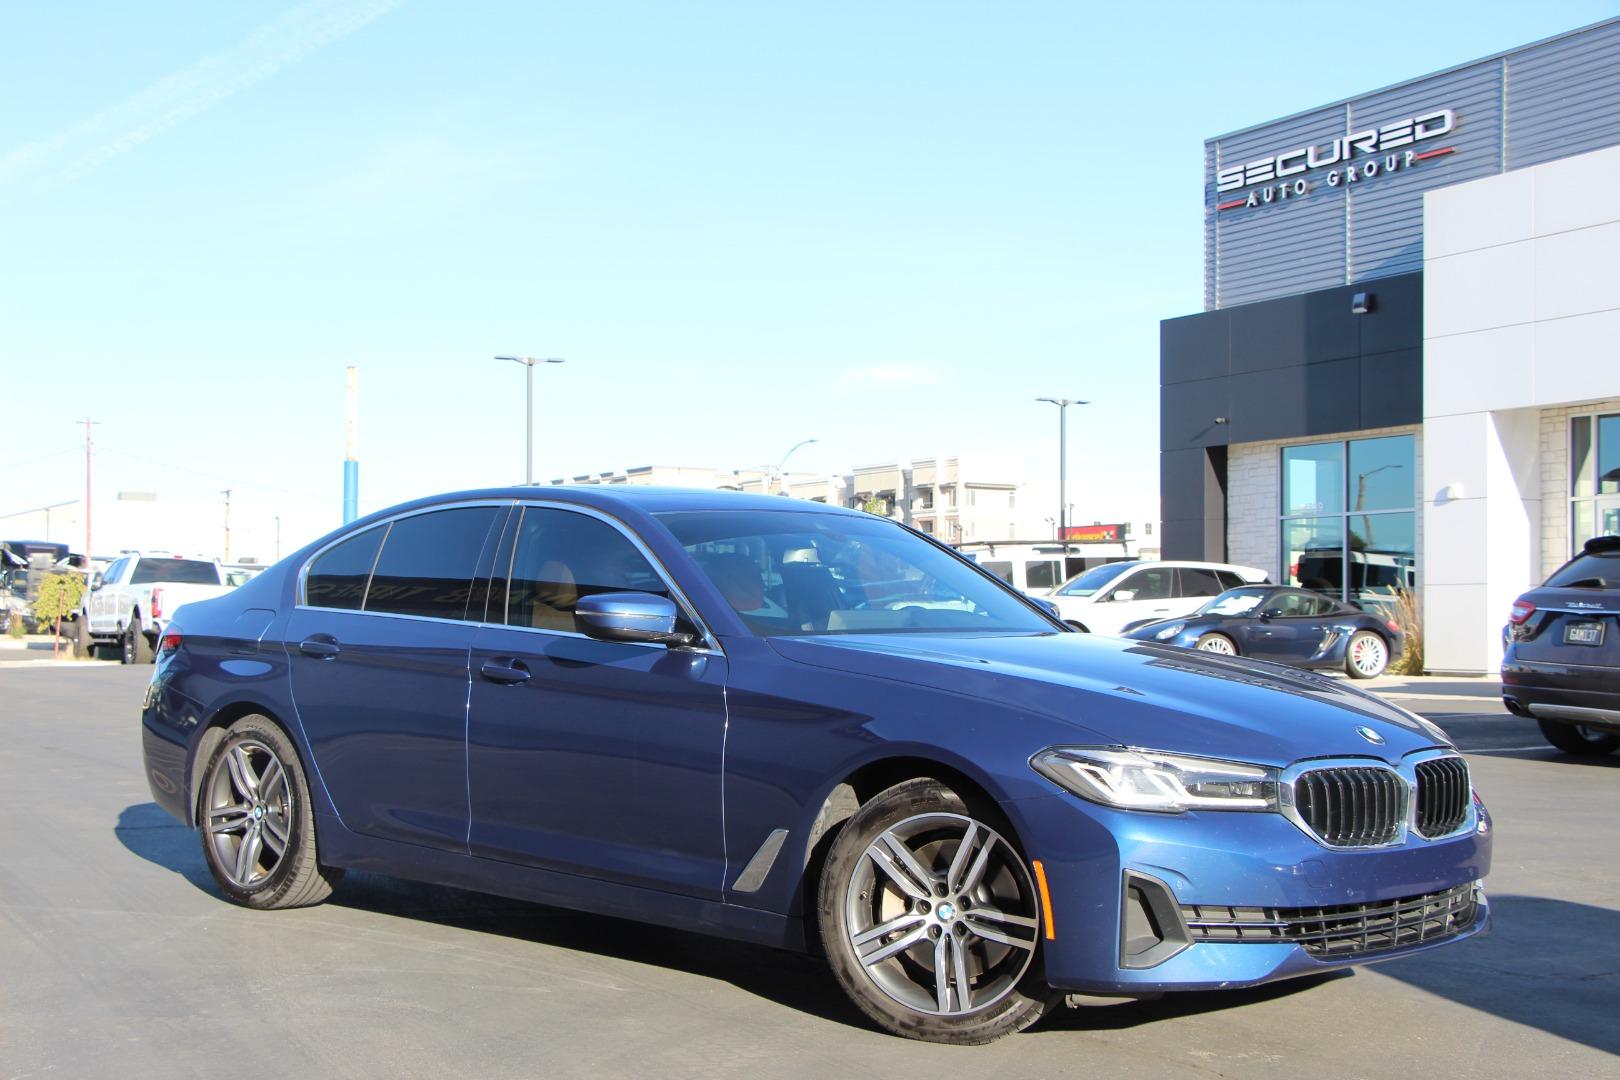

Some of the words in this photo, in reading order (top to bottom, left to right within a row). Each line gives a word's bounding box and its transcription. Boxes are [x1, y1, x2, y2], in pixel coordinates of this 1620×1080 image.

[1216, 108, 1455, 193] SECURED
[1246, 178, 1307, 208] AUTO
[1326, 150, 1417, 187] GROUP
